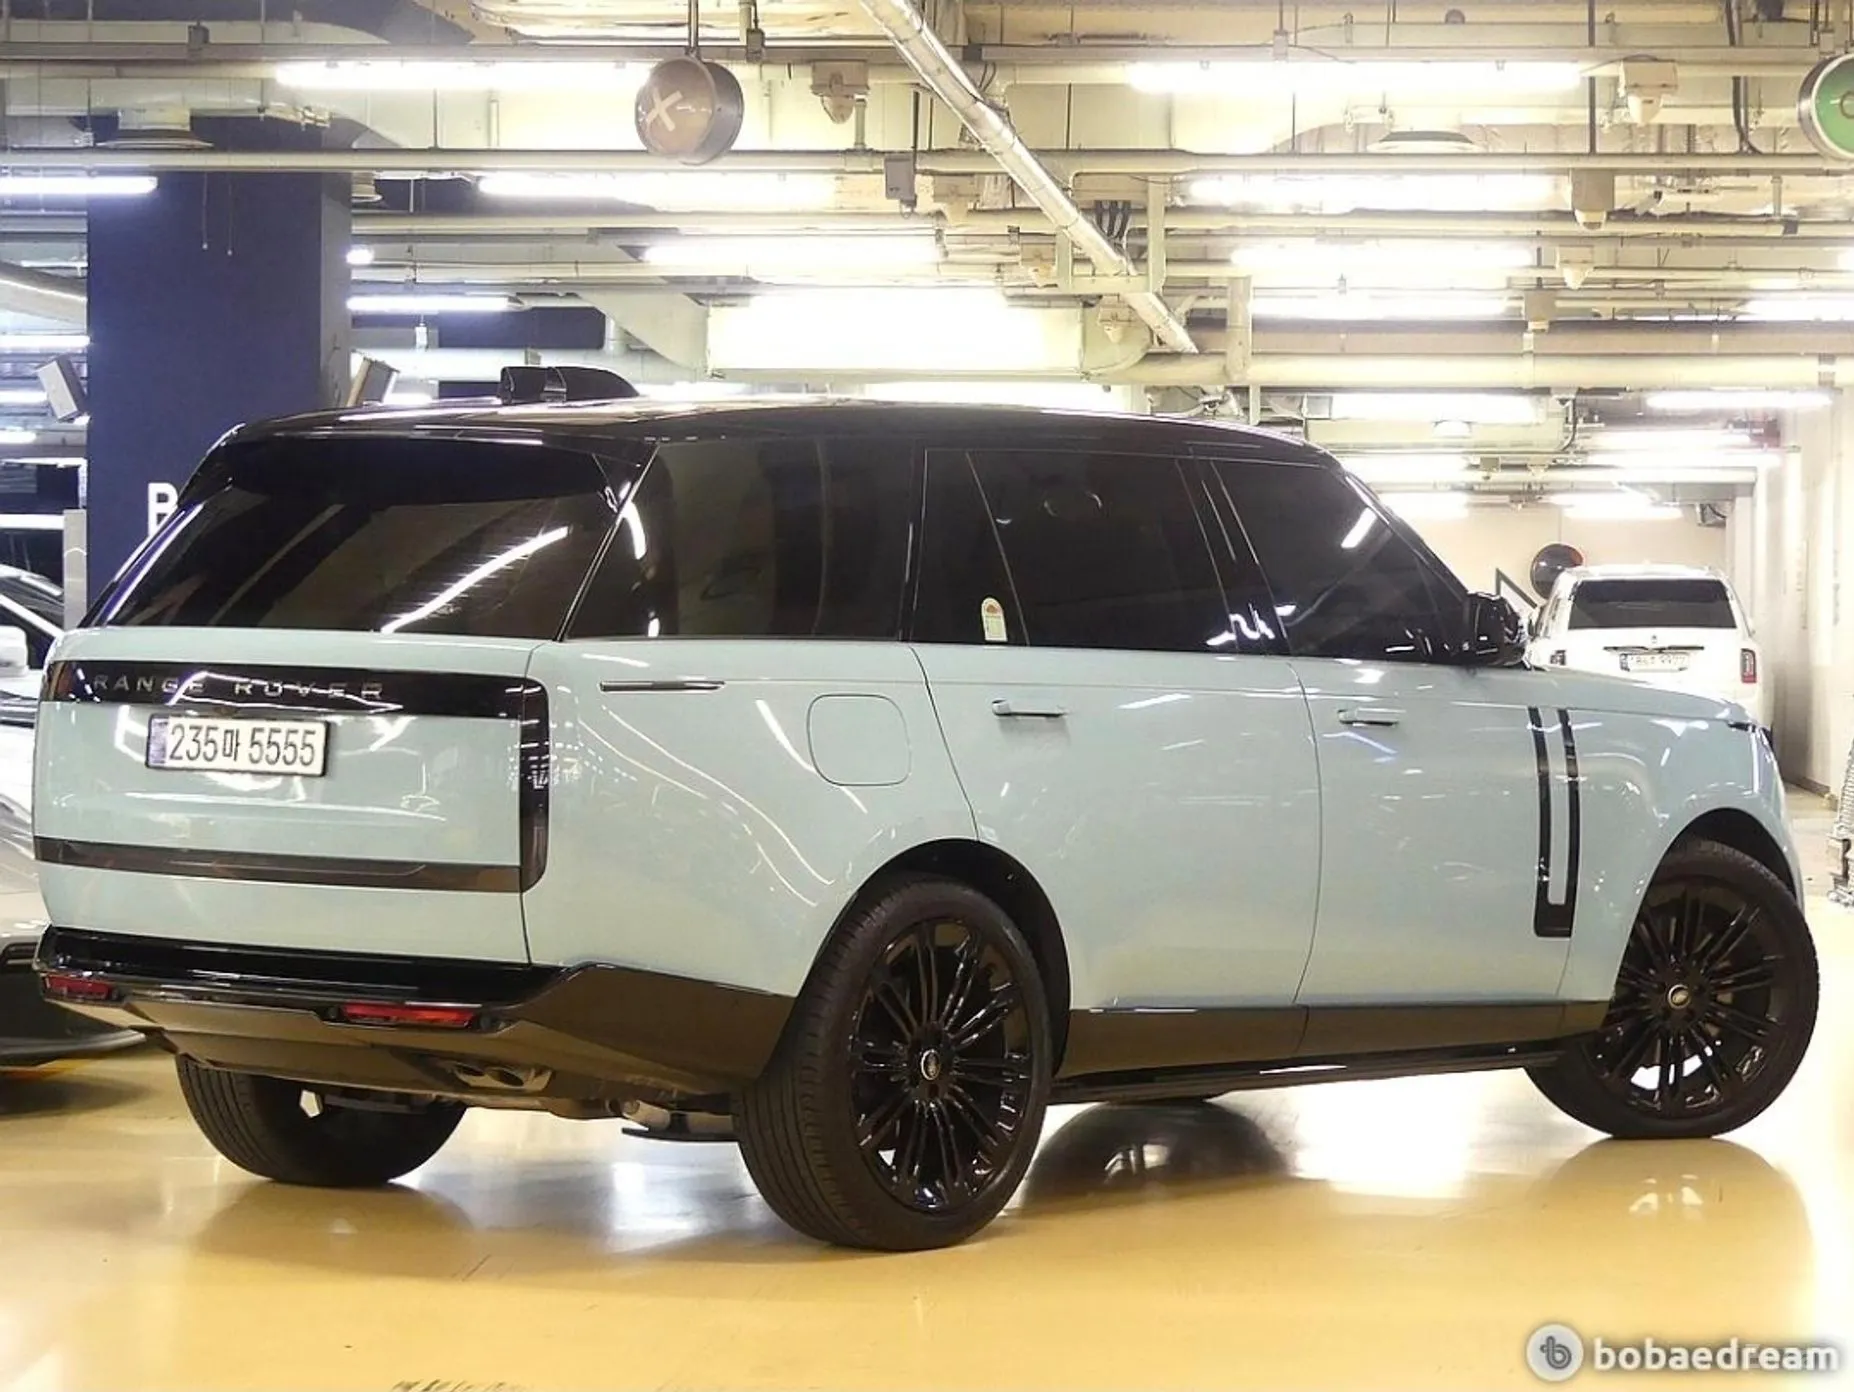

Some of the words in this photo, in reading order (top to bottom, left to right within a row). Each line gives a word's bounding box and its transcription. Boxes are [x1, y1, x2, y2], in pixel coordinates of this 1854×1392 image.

[93, 674, 205, 694] RANGE
[235, 679, 383, 700] ROVER
[169, 723, 240, 762] 235마
[248, 726, 317, 767] 5555
